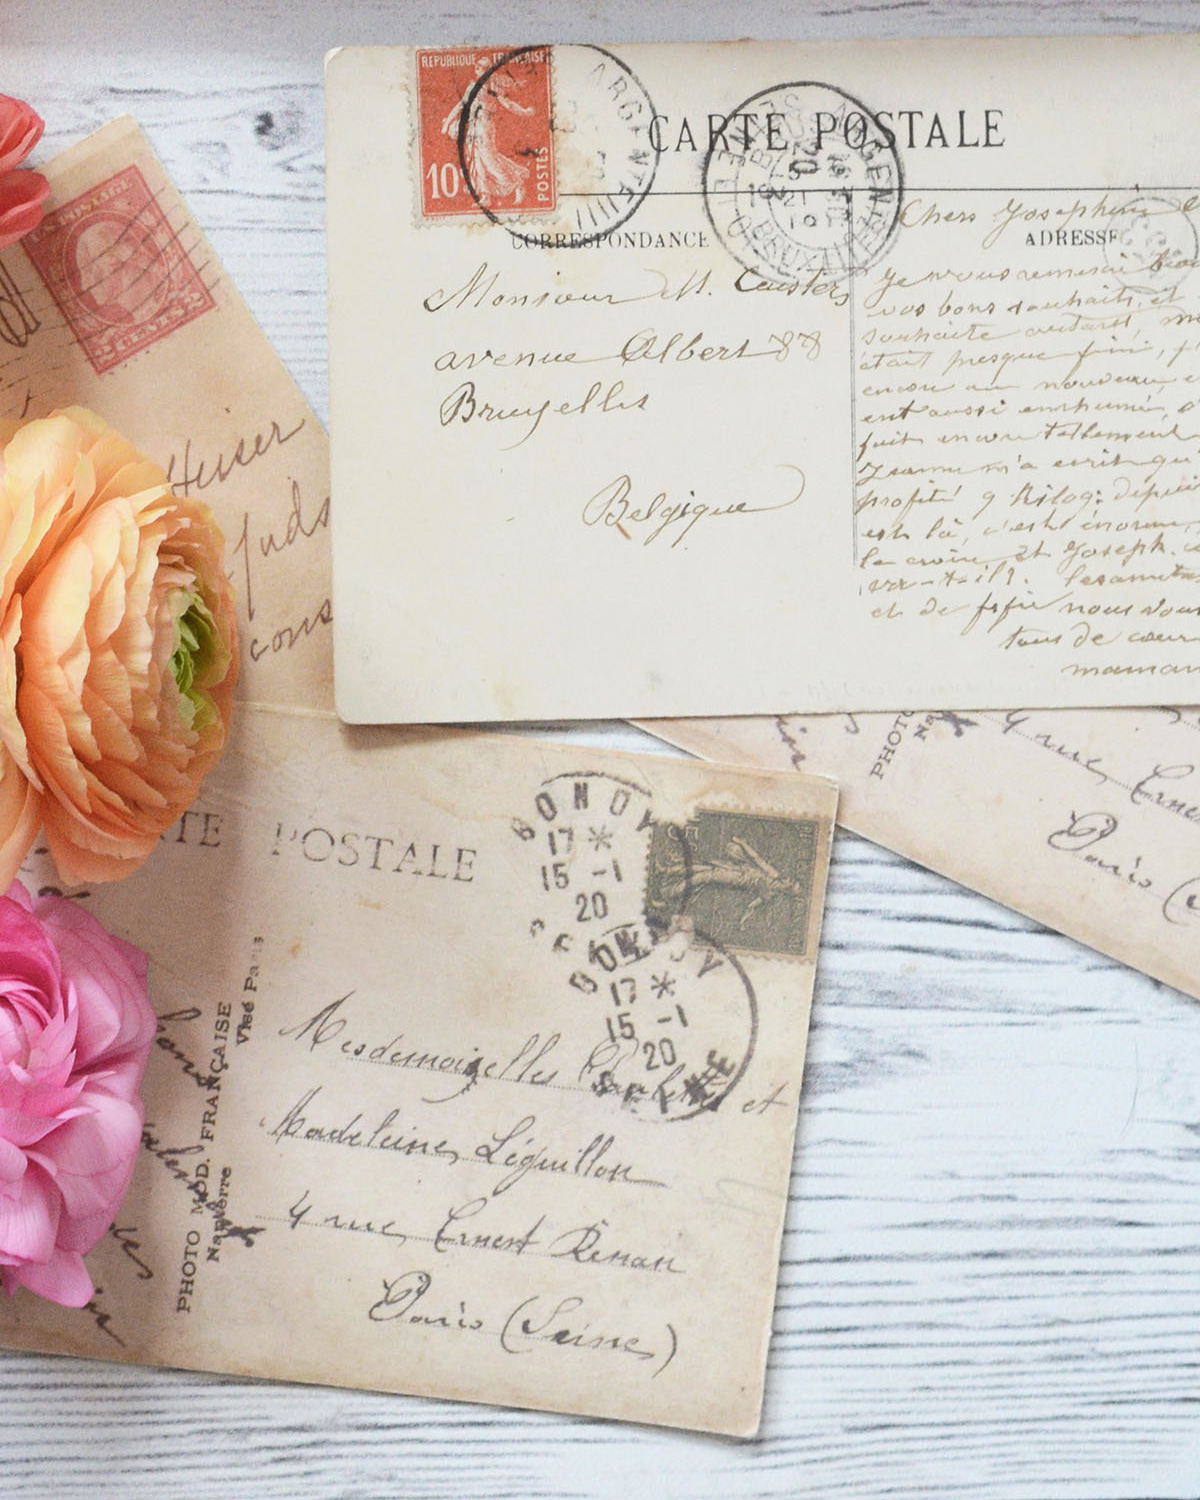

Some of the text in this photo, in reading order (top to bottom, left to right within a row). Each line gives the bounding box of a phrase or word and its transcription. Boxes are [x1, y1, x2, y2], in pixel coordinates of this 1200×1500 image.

[649, 109, 1007, 156] CARTE POSTALE
[536, 146, 550, 202] POSTES
[511, 230, 711, 250] CORRESPONDANCE
[271, 821, 480, 884] POSTALE
[540, 861, 570, 892] 15
[574, 891, 609, 923] 20
[605, 1012, 636, 1043] 15
[642, 1038, 677, 1072] 20
[176, 1228, 201, 1315] PHOTO
[200, 1000, 233, 1142] FRANÇAISE
